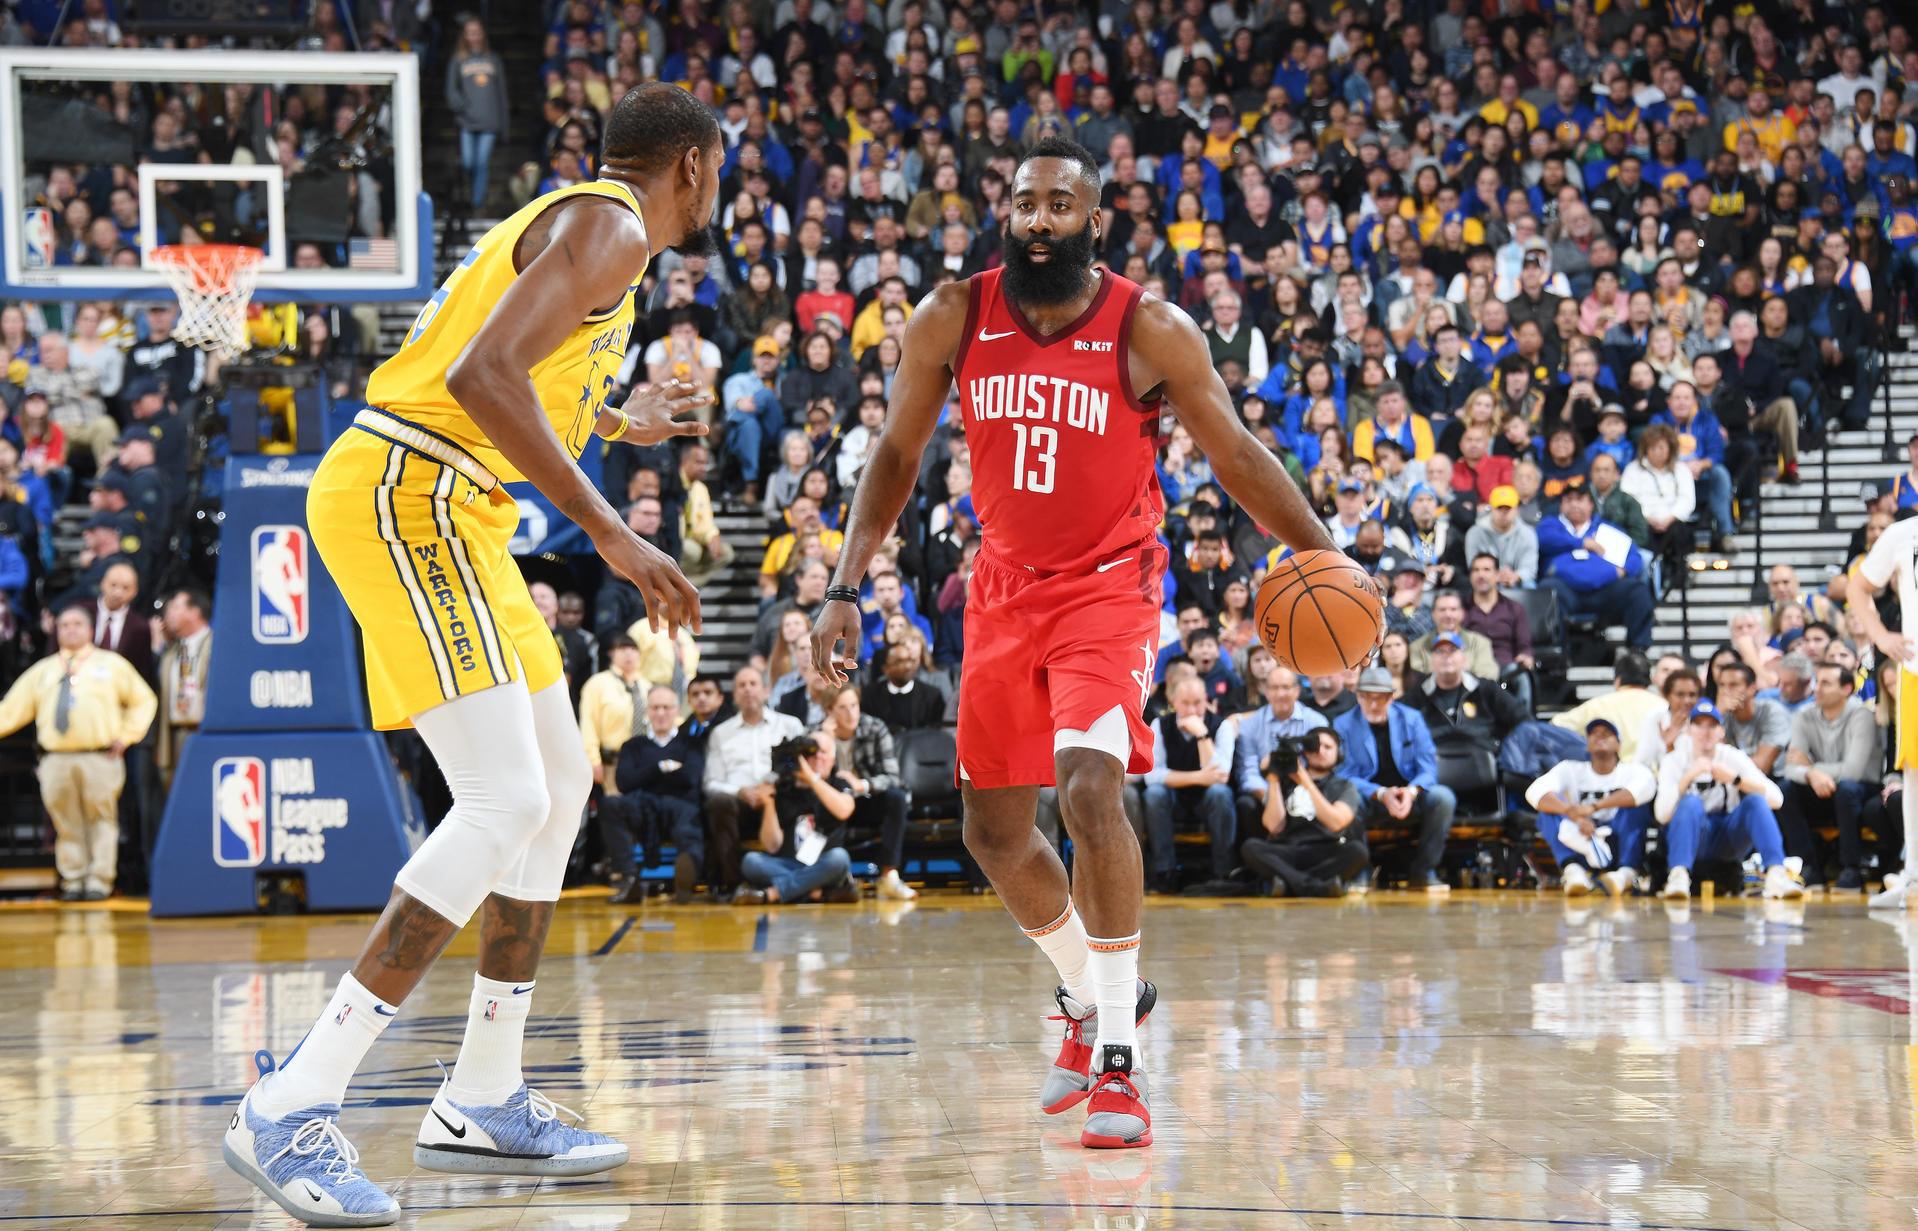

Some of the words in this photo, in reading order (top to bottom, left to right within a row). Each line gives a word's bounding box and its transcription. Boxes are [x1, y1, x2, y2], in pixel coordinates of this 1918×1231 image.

[970, 374, 1110, 436] HOUSTON
[1012, 422, 1058, 494] 13
[415, 543, 476, 672] WARRIORS
[250, 670, 313, 708] @NBA
[271, 757, 315, 794] NBA
[271, 793, 348, 833] League
[271, 828, 325, 864] Pass
